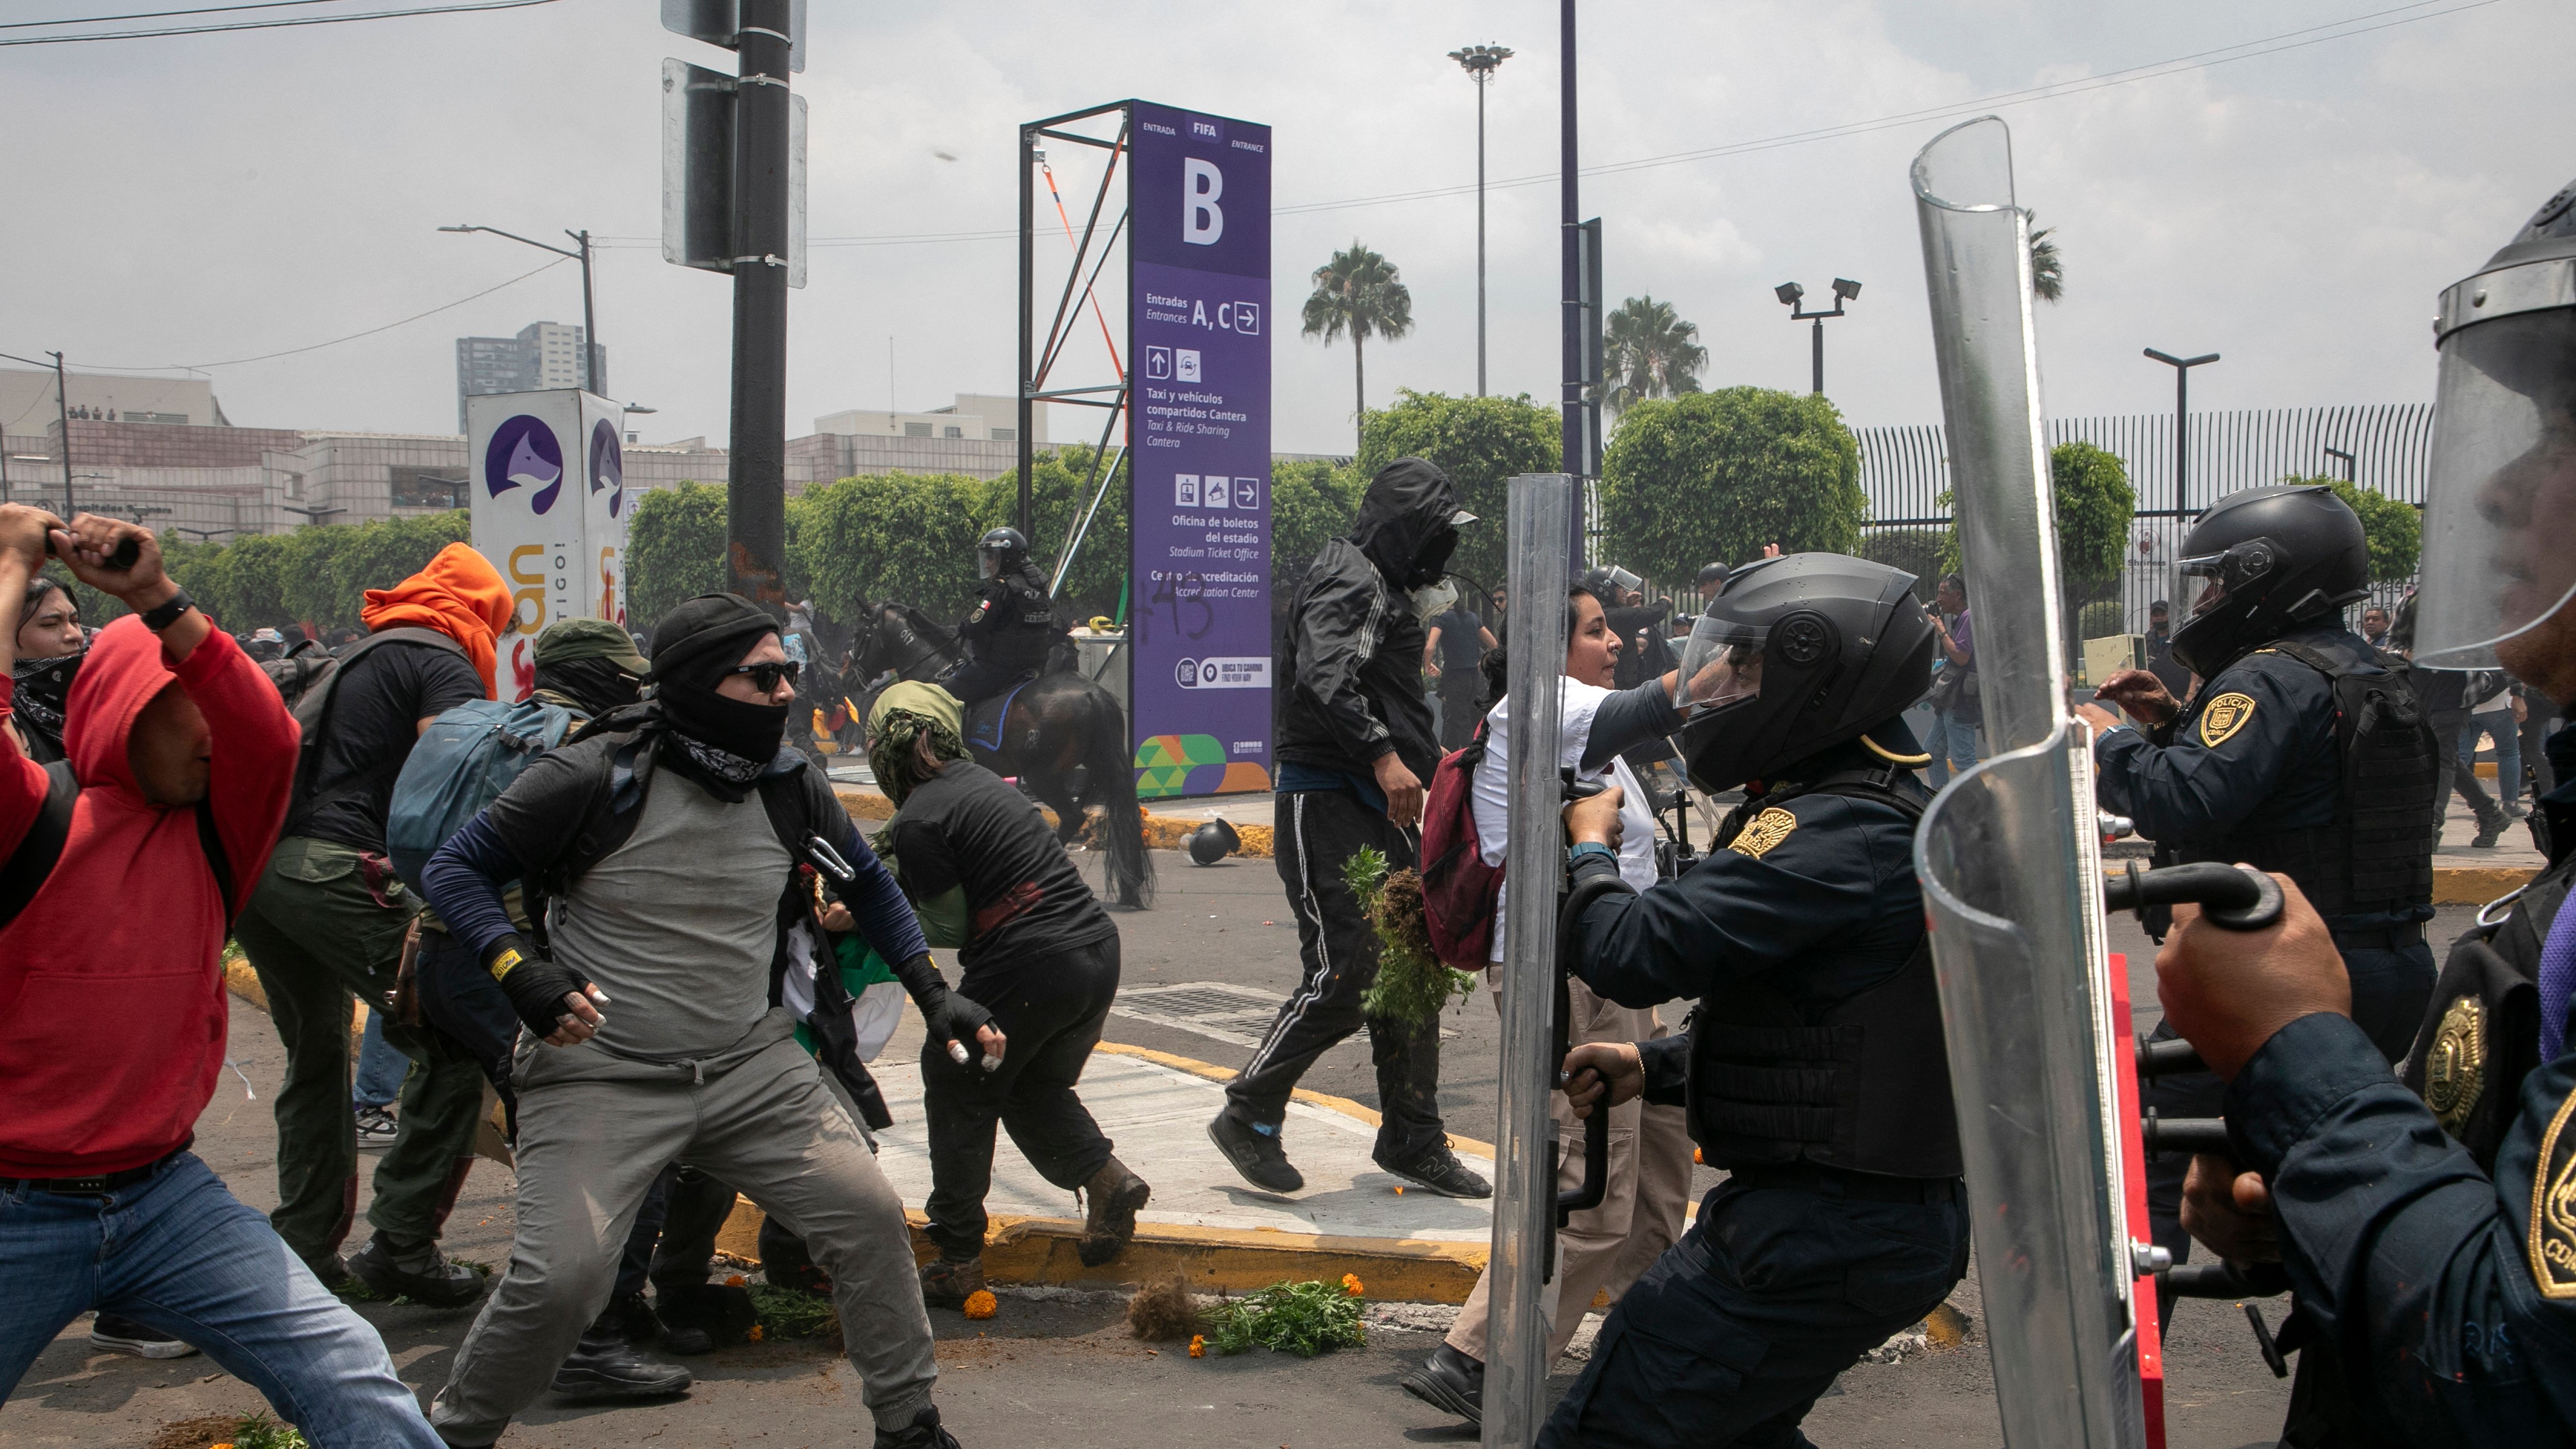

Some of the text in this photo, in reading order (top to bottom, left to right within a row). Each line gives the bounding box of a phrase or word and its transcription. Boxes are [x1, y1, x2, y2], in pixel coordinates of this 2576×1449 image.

[1143, 123, 1176, 135] ENTRADA
[1194, 122, 1216, 137] FIFA
[1231, 140, 1264, 152] ENTRANCE
[1183, 157, 1224, 245] B
[1146, 293, 1188, 308] Entradas
[1146, 309, 1187, 323] Entrances
[1192, 300, 1230, 330] A, C
[1147, 388, 1223, 404] Taxi y vehículos
[1147, 405, 1246, 421] compartidos Cantera
[1147, 420, 1230, 438] Taxi & Ride Sharing
[1147, 435, 1180, 447] Cantera
[1173, 515, 1259, 529] Oficina de boletos
[1206, 532, 1259, 544] del estadio
[1169, 546, 1259, 561] Stadium Ticket Office
[1151, 570, 1183, 581] Ceto
[1175, 587, 1259, 598] Accredtation Center
[1237, 663, 1243, 672] TU
